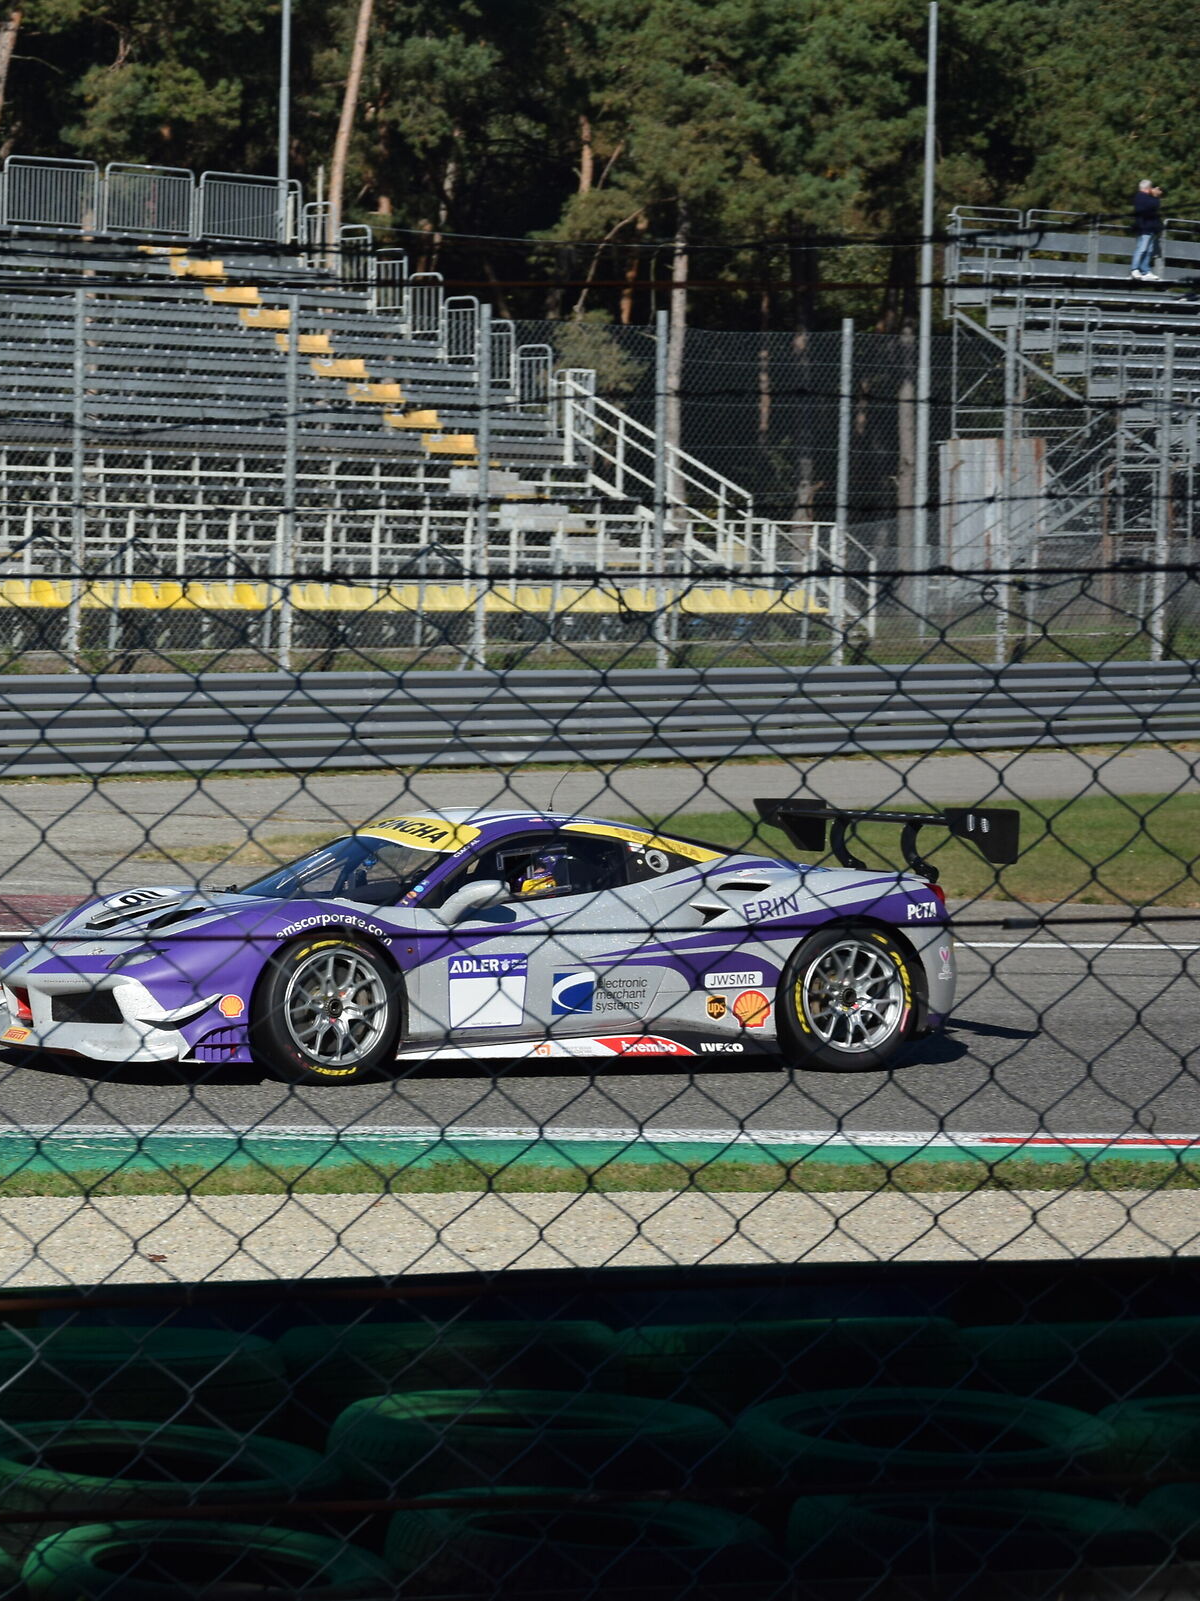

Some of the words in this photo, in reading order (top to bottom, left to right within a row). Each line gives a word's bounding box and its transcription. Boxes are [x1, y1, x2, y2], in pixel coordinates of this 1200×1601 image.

[367, 819, 449, 844] SINGHA
[743, 894, 799, 922] ERIN
[276, 913, 393, 947] emscorporate.com
[449, 959, 500, 974] ADLER
[597, 977, 648, 989] electronic
[710, 974, 756, 986] JWSMR
[596, 989, 646, 1000] merchant
[595, 1001, 640, 1014] systems
[708, 1002, 725, 1016] ups
[620, 1041, 678, 1053] brembo
[700, 1042, 744, 1052] IVECO
